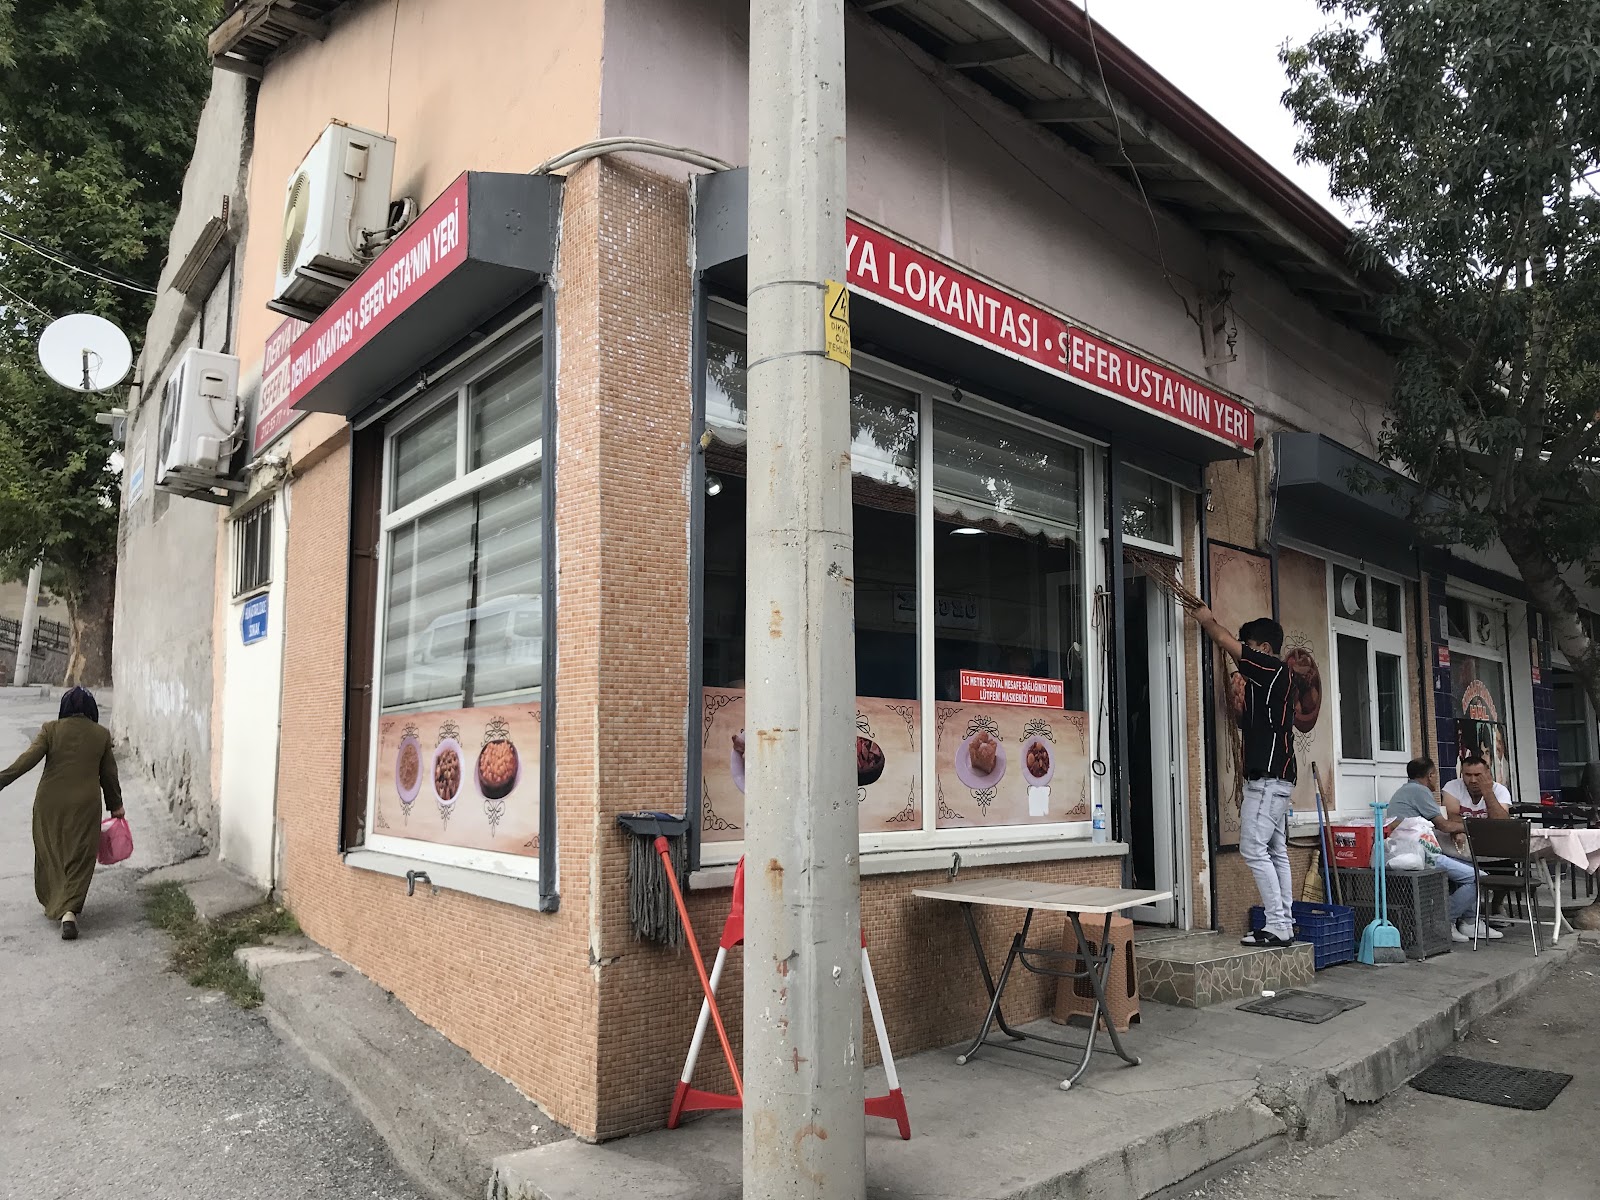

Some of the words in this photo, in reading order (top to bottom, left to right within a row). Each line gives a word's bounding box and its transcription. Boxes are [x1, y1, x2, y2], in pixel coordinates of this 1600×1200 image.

[291, 347, 311, 392] DERYA
[312, 307, 353, 373] LOKANTASI
[359, 277, 385, 330] SEFER
[386, 232, 431, 305] USTA'NIN
[433, 197, 459, 264] YERİ
[264, 323, 292, 373] DERYA
[888, 251, 1039, 352] LOKANTASI
[1057, 331, 1122, 387] SEFER
[1126, 359, 1211, 424] USTA'NIN
[1213, 408, 1249, 441] YERİ
[259, 368, 282, 416] SEFER
[970, 676, 986, 688] METRE
[986, 678, 1004, 689] SOSYAL
[1004, 680, 1022, 691] MESAFE
